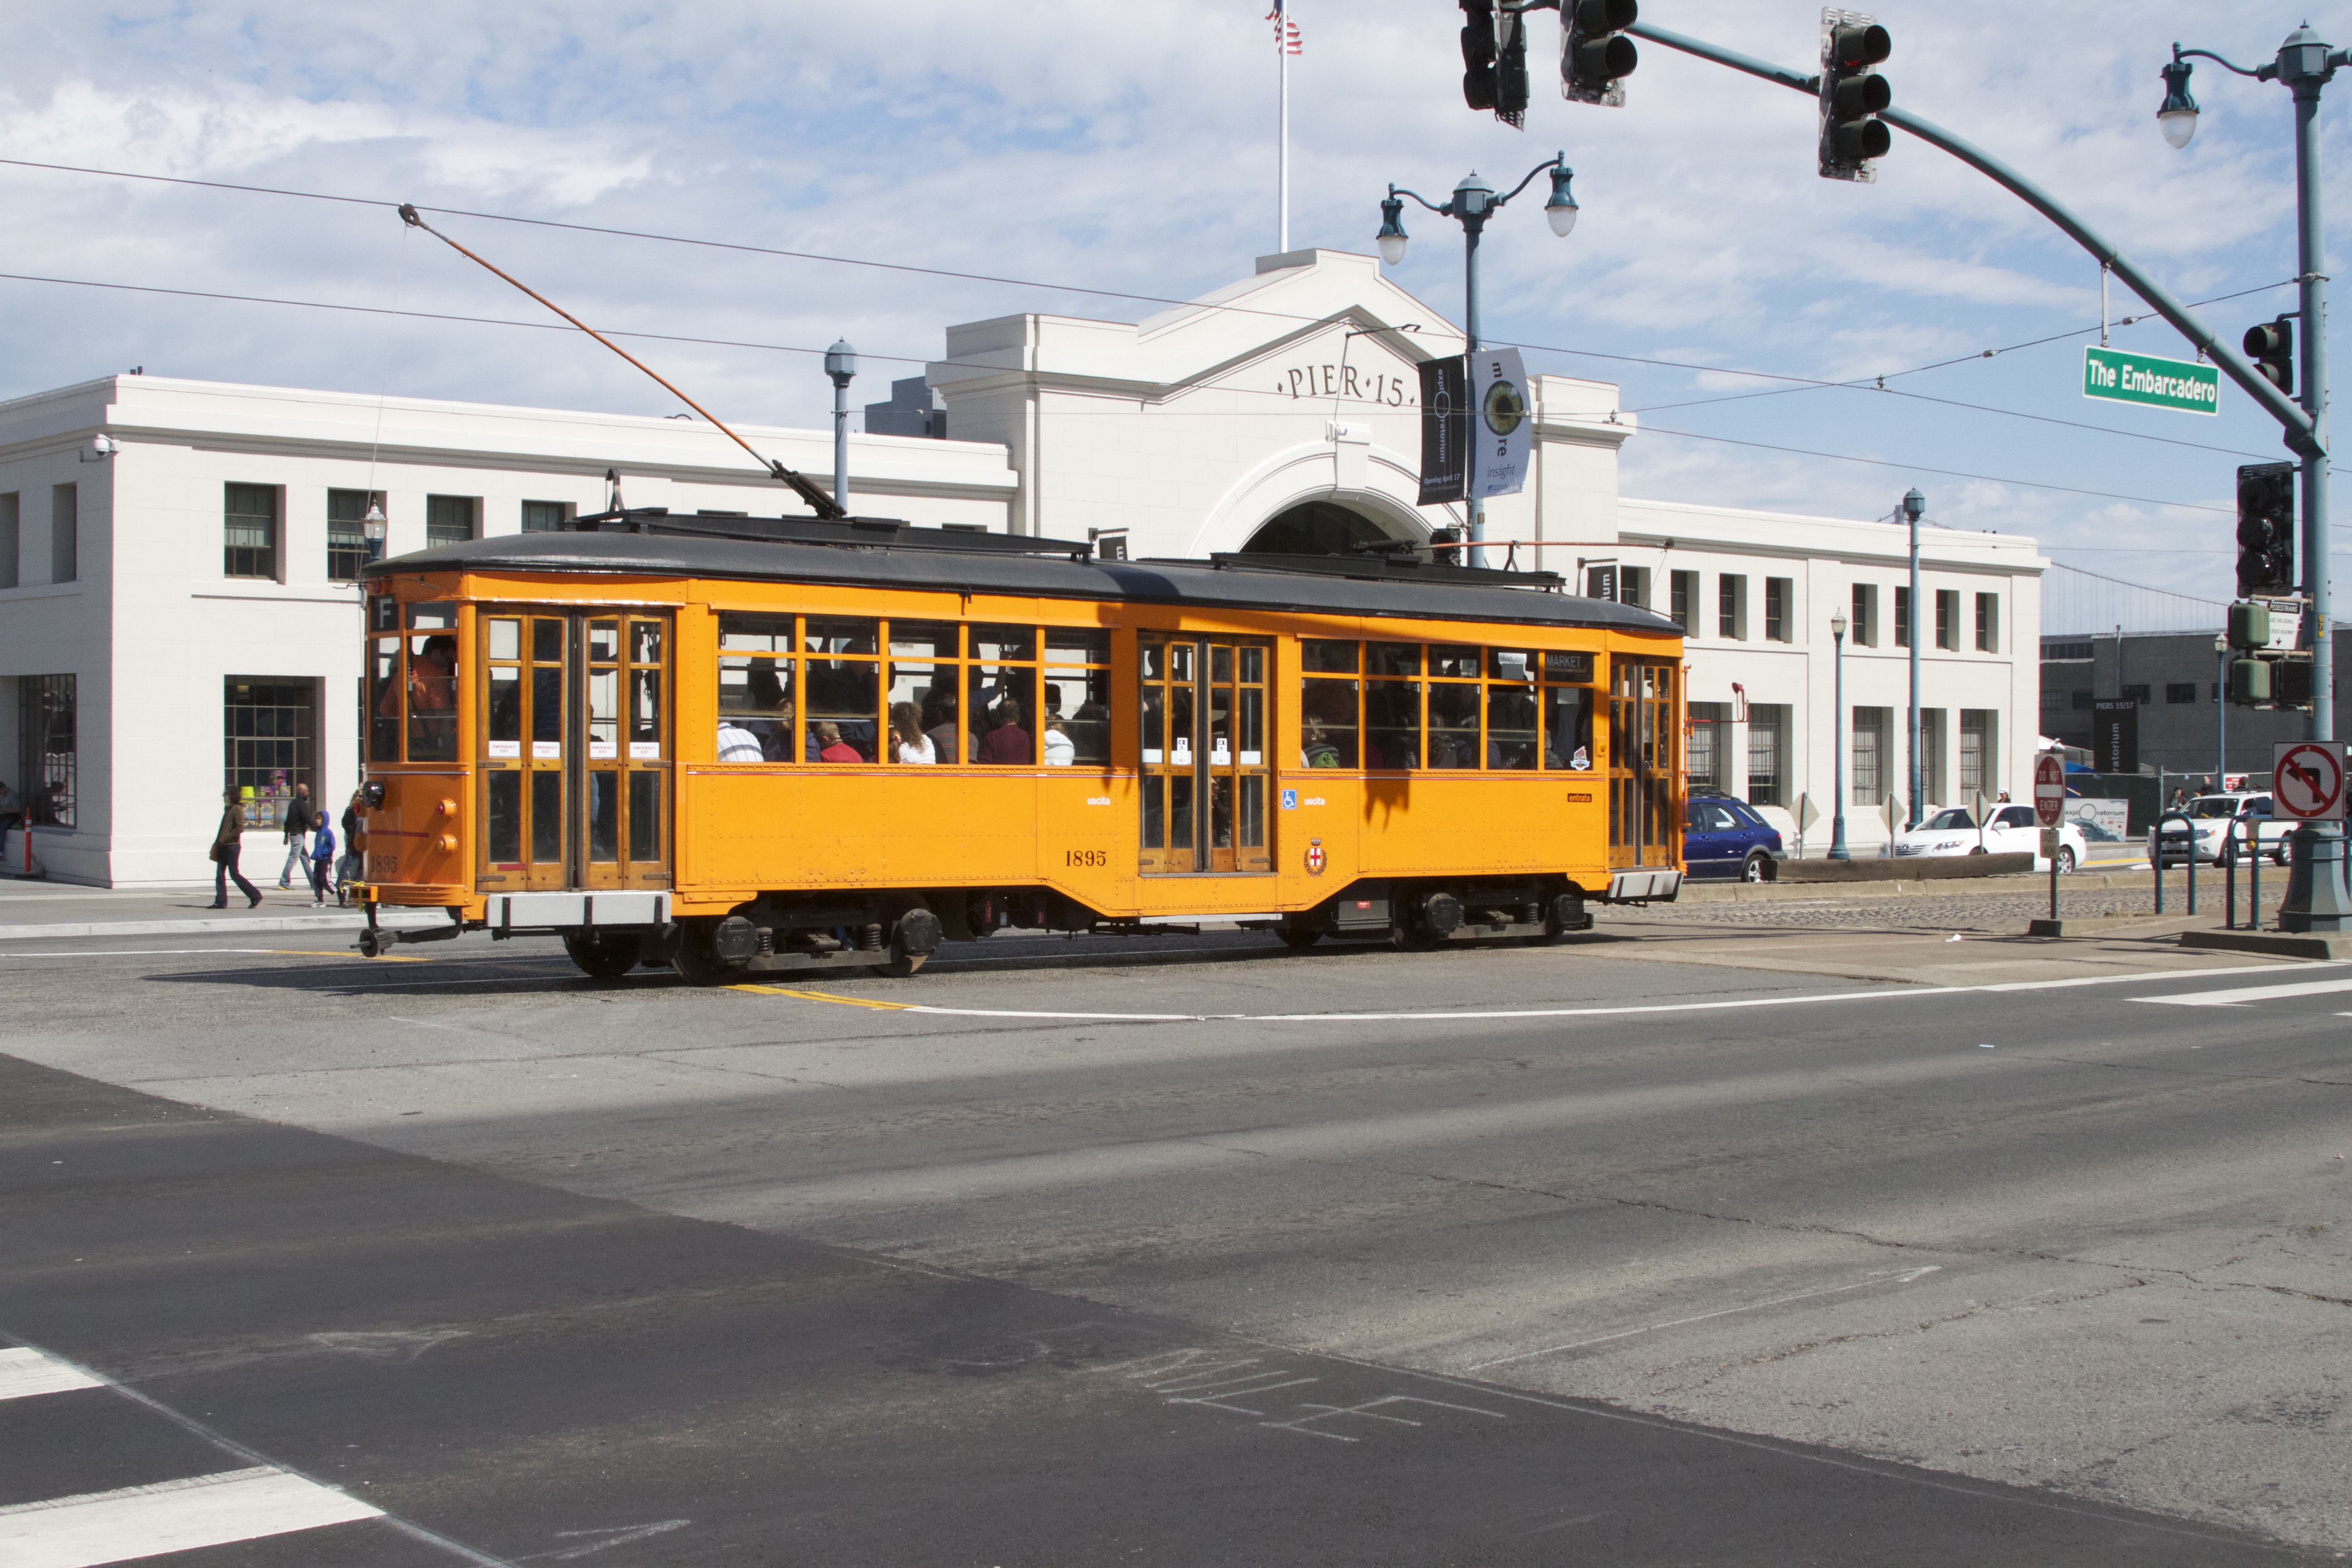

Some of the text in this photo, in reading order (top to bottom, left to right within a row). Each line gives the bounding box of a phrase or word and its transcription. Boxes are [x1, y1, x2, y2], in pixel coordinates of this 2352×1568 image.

[1287, 365, 1403, 407] PIER 15
[2088, 359, 2215, 403] The Embarcadero
[1487, 464, 1515, 479] insight
[379, 598, 392, 628] F
[2269, 603, 2298, 612] PEDESTRIANS
[1546, 655, 1582, 668] MARKET
[2115, 701, 2134, 710] 15/17
[2038, 770, 2060, 781] DO NOT
[1087, 796, 1110, 805] uscita
[1304, 797, 1325, 805] uscita
[2040, 800, 2058, 811] ENTER
[371, 855, 397, 873] 1895
[1066, 850, 1106, 867] 1895
